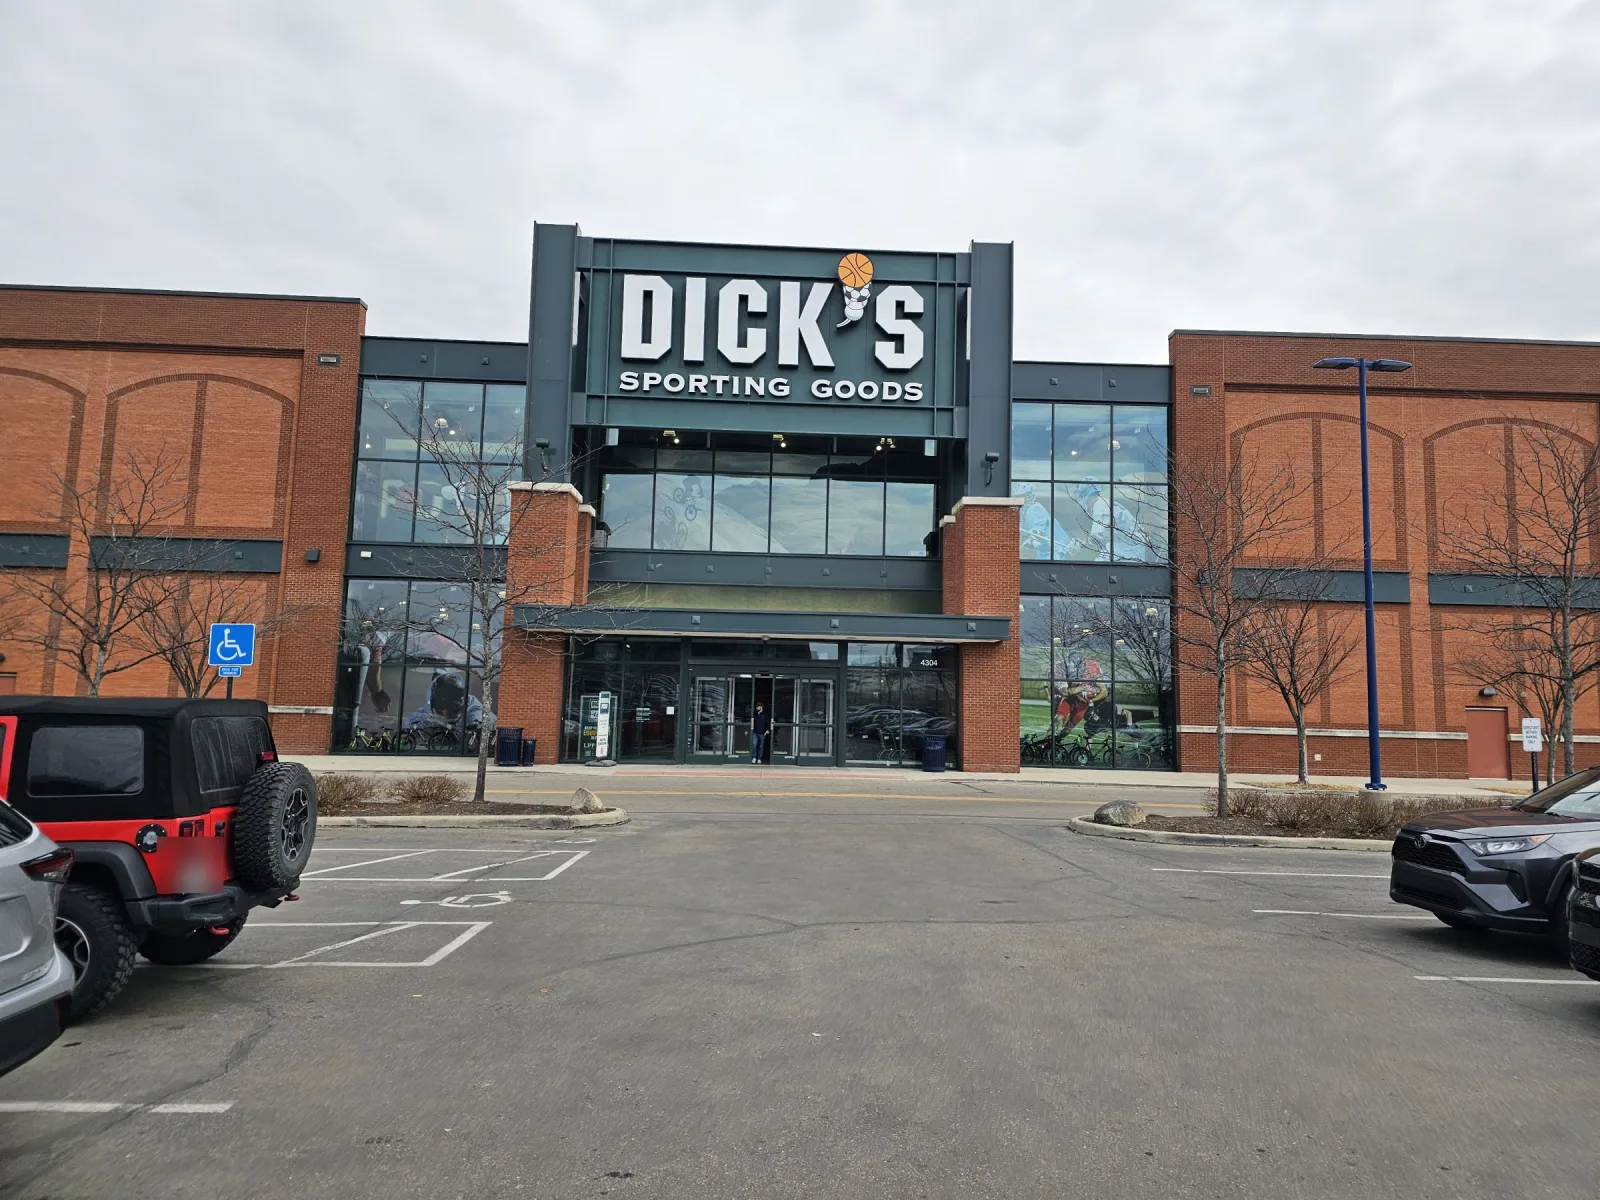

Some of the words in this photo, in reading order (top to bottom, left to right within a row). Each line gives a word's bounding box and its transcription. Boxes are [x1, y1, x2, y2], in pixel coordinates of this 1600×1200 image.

[620, 252, 924, 370] DICK'S
[619, 371, 790, 398] SPORTING
[811, 379, 924, 402] GOODS
